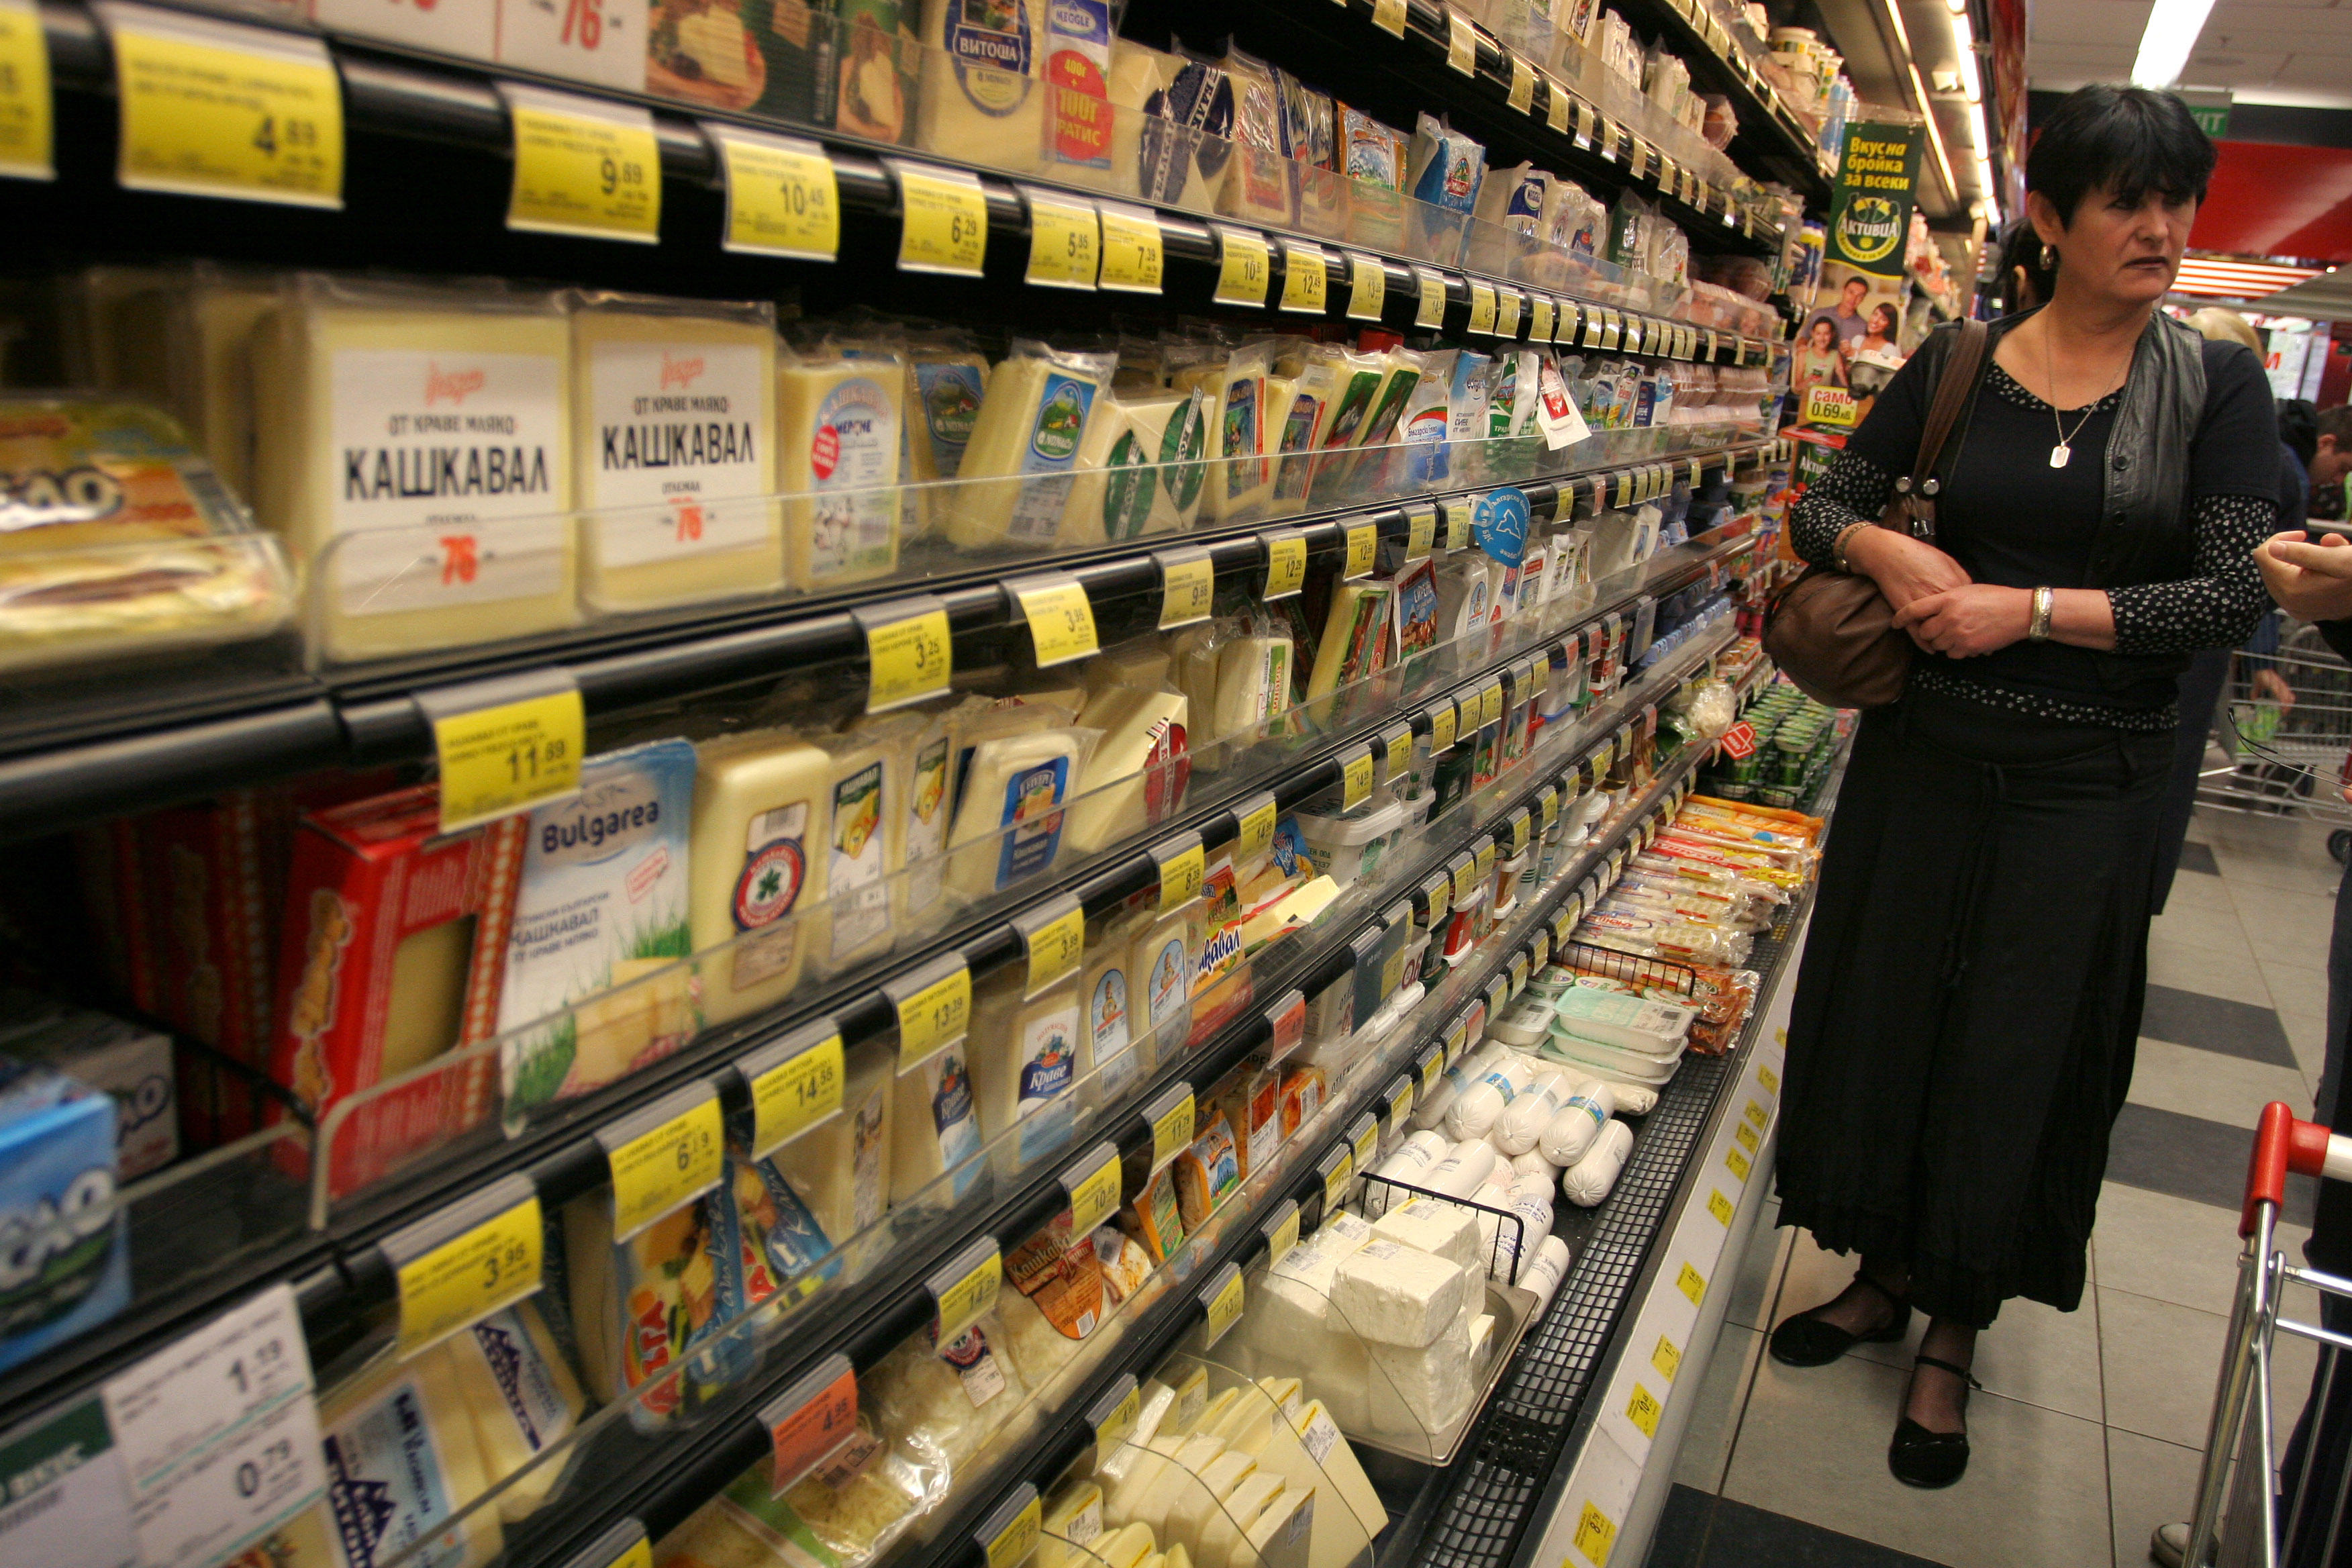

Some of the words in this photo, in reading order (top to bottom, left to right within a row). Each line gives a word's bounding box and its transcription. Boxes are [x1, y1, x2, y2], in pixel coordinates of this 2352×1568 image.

[1055, 10, 1090, 28] MEGGLE
[960, 36, 1018, 62] ВИТОША
[1849, 136, 1907, 158] Вкусна
[1847, 154, 1904, 173] бройка
[1843, 173, 1859, 187] за
[1864, 175, 1910, 190] всеки
[634, 397, 649, 416] ОТ
[653, 397, 687, 413] КРАВЕ
[691, 396, 728, 414] МЛЯКО
[1814, 390, 1853, 405] само
[1812, 402, 1841, 419] 0.69
[603, 422, 754, 469] КАШКАВАЛ
[344, 446, 549, 501] КАШКАВАЛ
[542, 801, 659, 853] Bulgarea
[1028, 1064, 1067, 1091] Краве
